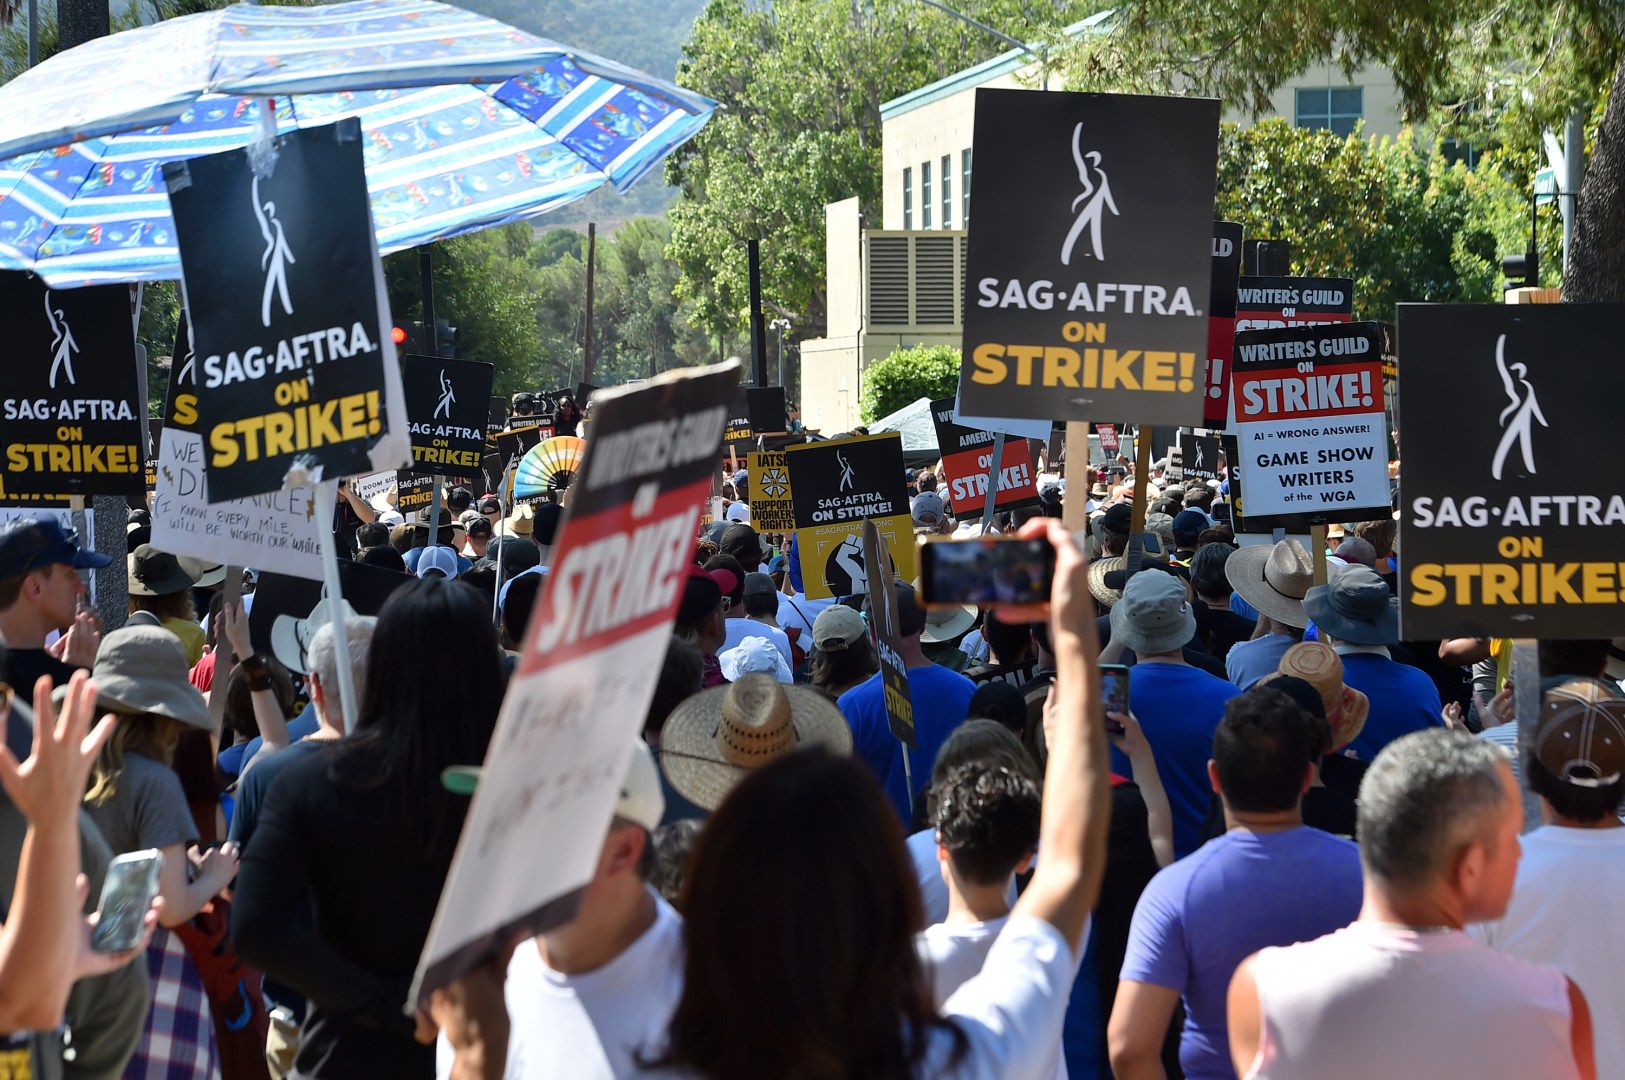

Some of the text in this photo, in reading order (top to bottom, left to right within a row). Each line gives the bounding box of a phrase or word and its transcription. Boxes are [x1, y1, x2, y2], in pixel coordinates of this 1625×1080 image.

[1302, 289, 1345, 306] GUILD
[1281, 307, 1296, 318] ON
[1062, 320, 1107, 343] ON
[1239, 336, 1369, 362] WRITERS GUILD
[971, 342, 1196, 393] STRIKE!
[1297, 361, 1314, 373] ON
[274, 377, 310, 407] ON
[1242, 370, 1374, 415] STRIKE!
[56, 426, 83, 442] ON
[209, 389, 382, 468] STRIKE!
[512, 420, 535, 428] WRITERS
[724, 428, 751, 441] RIKE!
[1254, 432, 1265, 441] AI
[1276, 428, 1319, 439] WRONG
[1322, 425, 1371, 436] ANSWER!
[432, 439, 449, 448] ON
[585, 420, 674, 491] WRITERS
[668, 406, 728, 466] GUILD
[959, 431, 996, 447] AMERIC
[6, 443, 139, 474] STRIKE!
[172, 440, 199, 464] WE
[412, 445, 480, 468] TRIKE!
[1256, 446, 1374, 468] GAME SHOW
[362, 481, 383, 492] ROOM
[951, 463, 1031, 501] STRKE!
[1278, 469, 1354, 488] WRITERS
[631, 482, 661, 520] ON
[751, 499, 794, 511] SUPPORT
[1284, 490, 1356, 503] of the WGA
[180, 504, 207, 520] KNOW
[216, 510, 249, 528] EVERY
[812, 502, 893, 522] ON STRIKE!
[205, 524, 223, 537] BE
[231, 528, 264, 544] WORTH
[268, 537, 288, 548] OUR
[760, 520, 794, 530] RIGHTS
[1498, 536, 1543, 559] ON
[536, 504, 699, 653] STRIKE!
